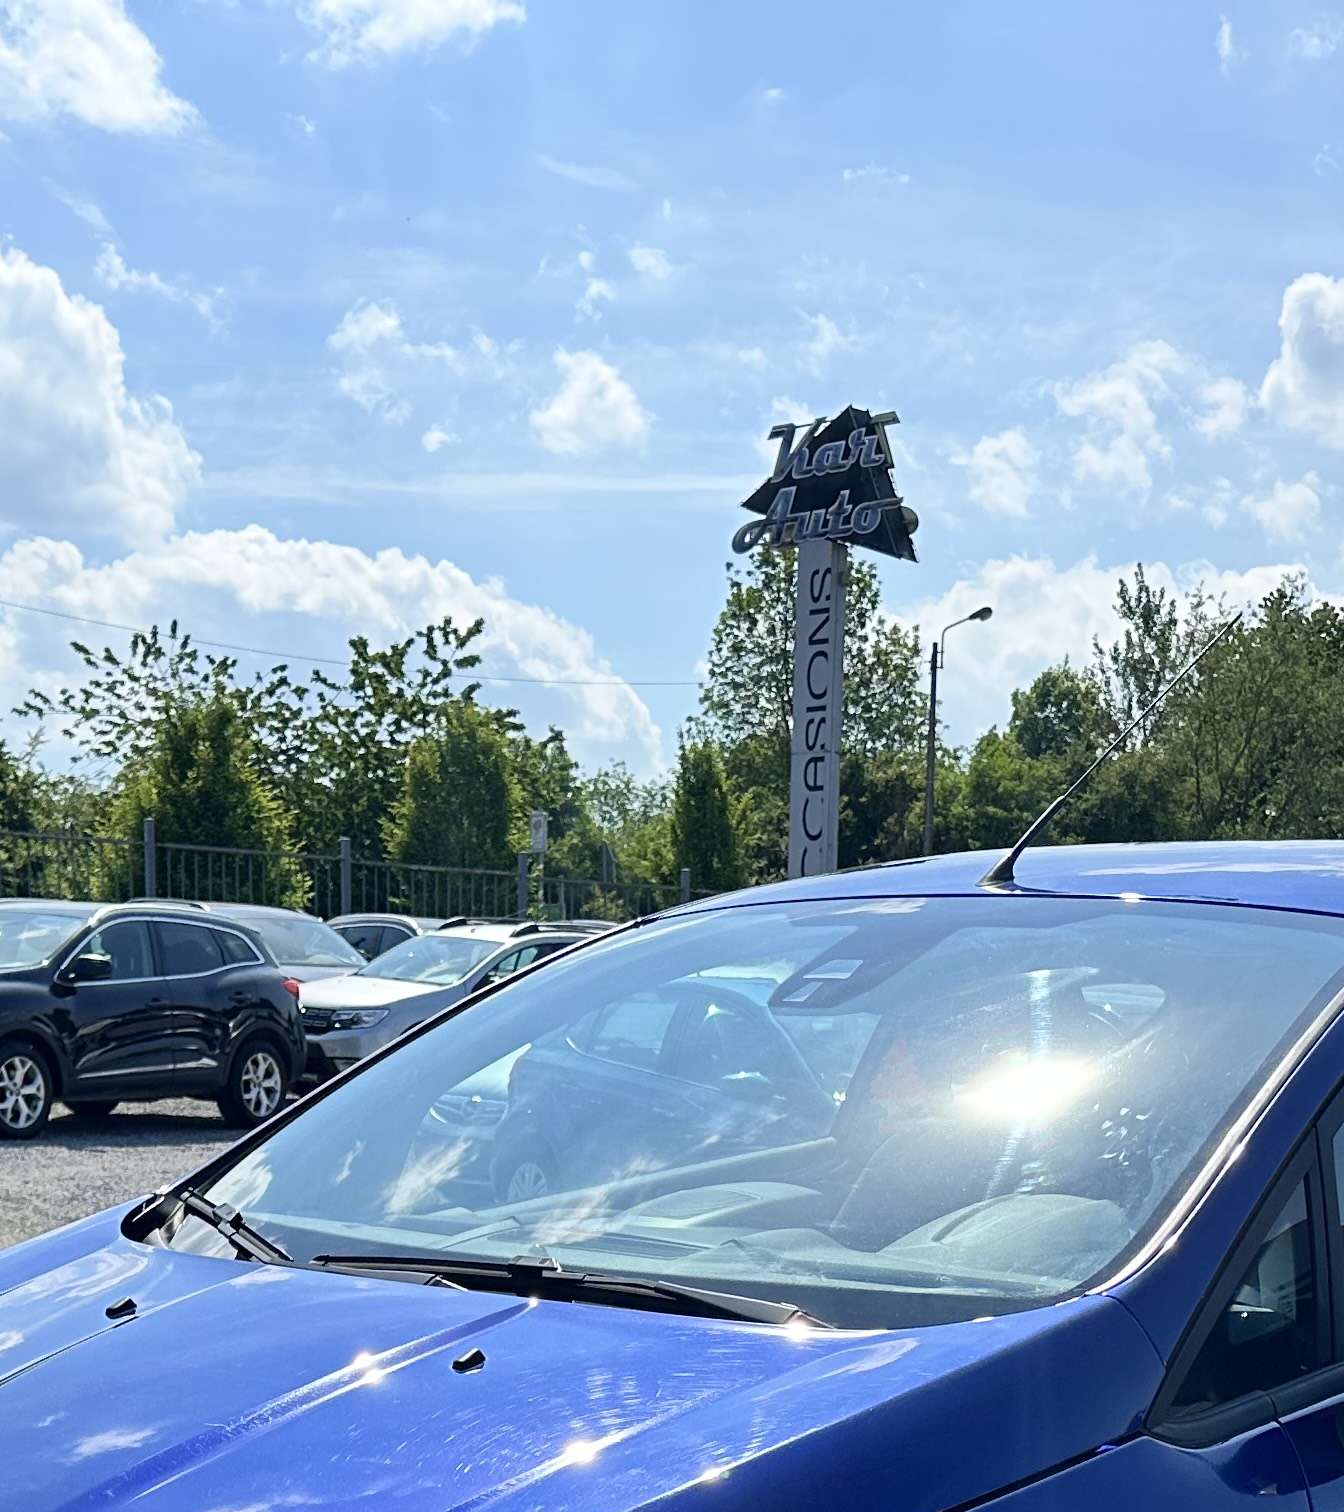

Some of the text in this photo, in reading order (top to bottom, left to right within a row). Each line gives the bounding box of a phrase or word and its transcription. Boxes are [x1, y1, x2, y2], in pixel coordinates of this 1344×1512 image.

[767, 417, 886, 484] Kar
[732, 486, 903, 554] Auto
[800, 566, 833, 878] CCASIONS
